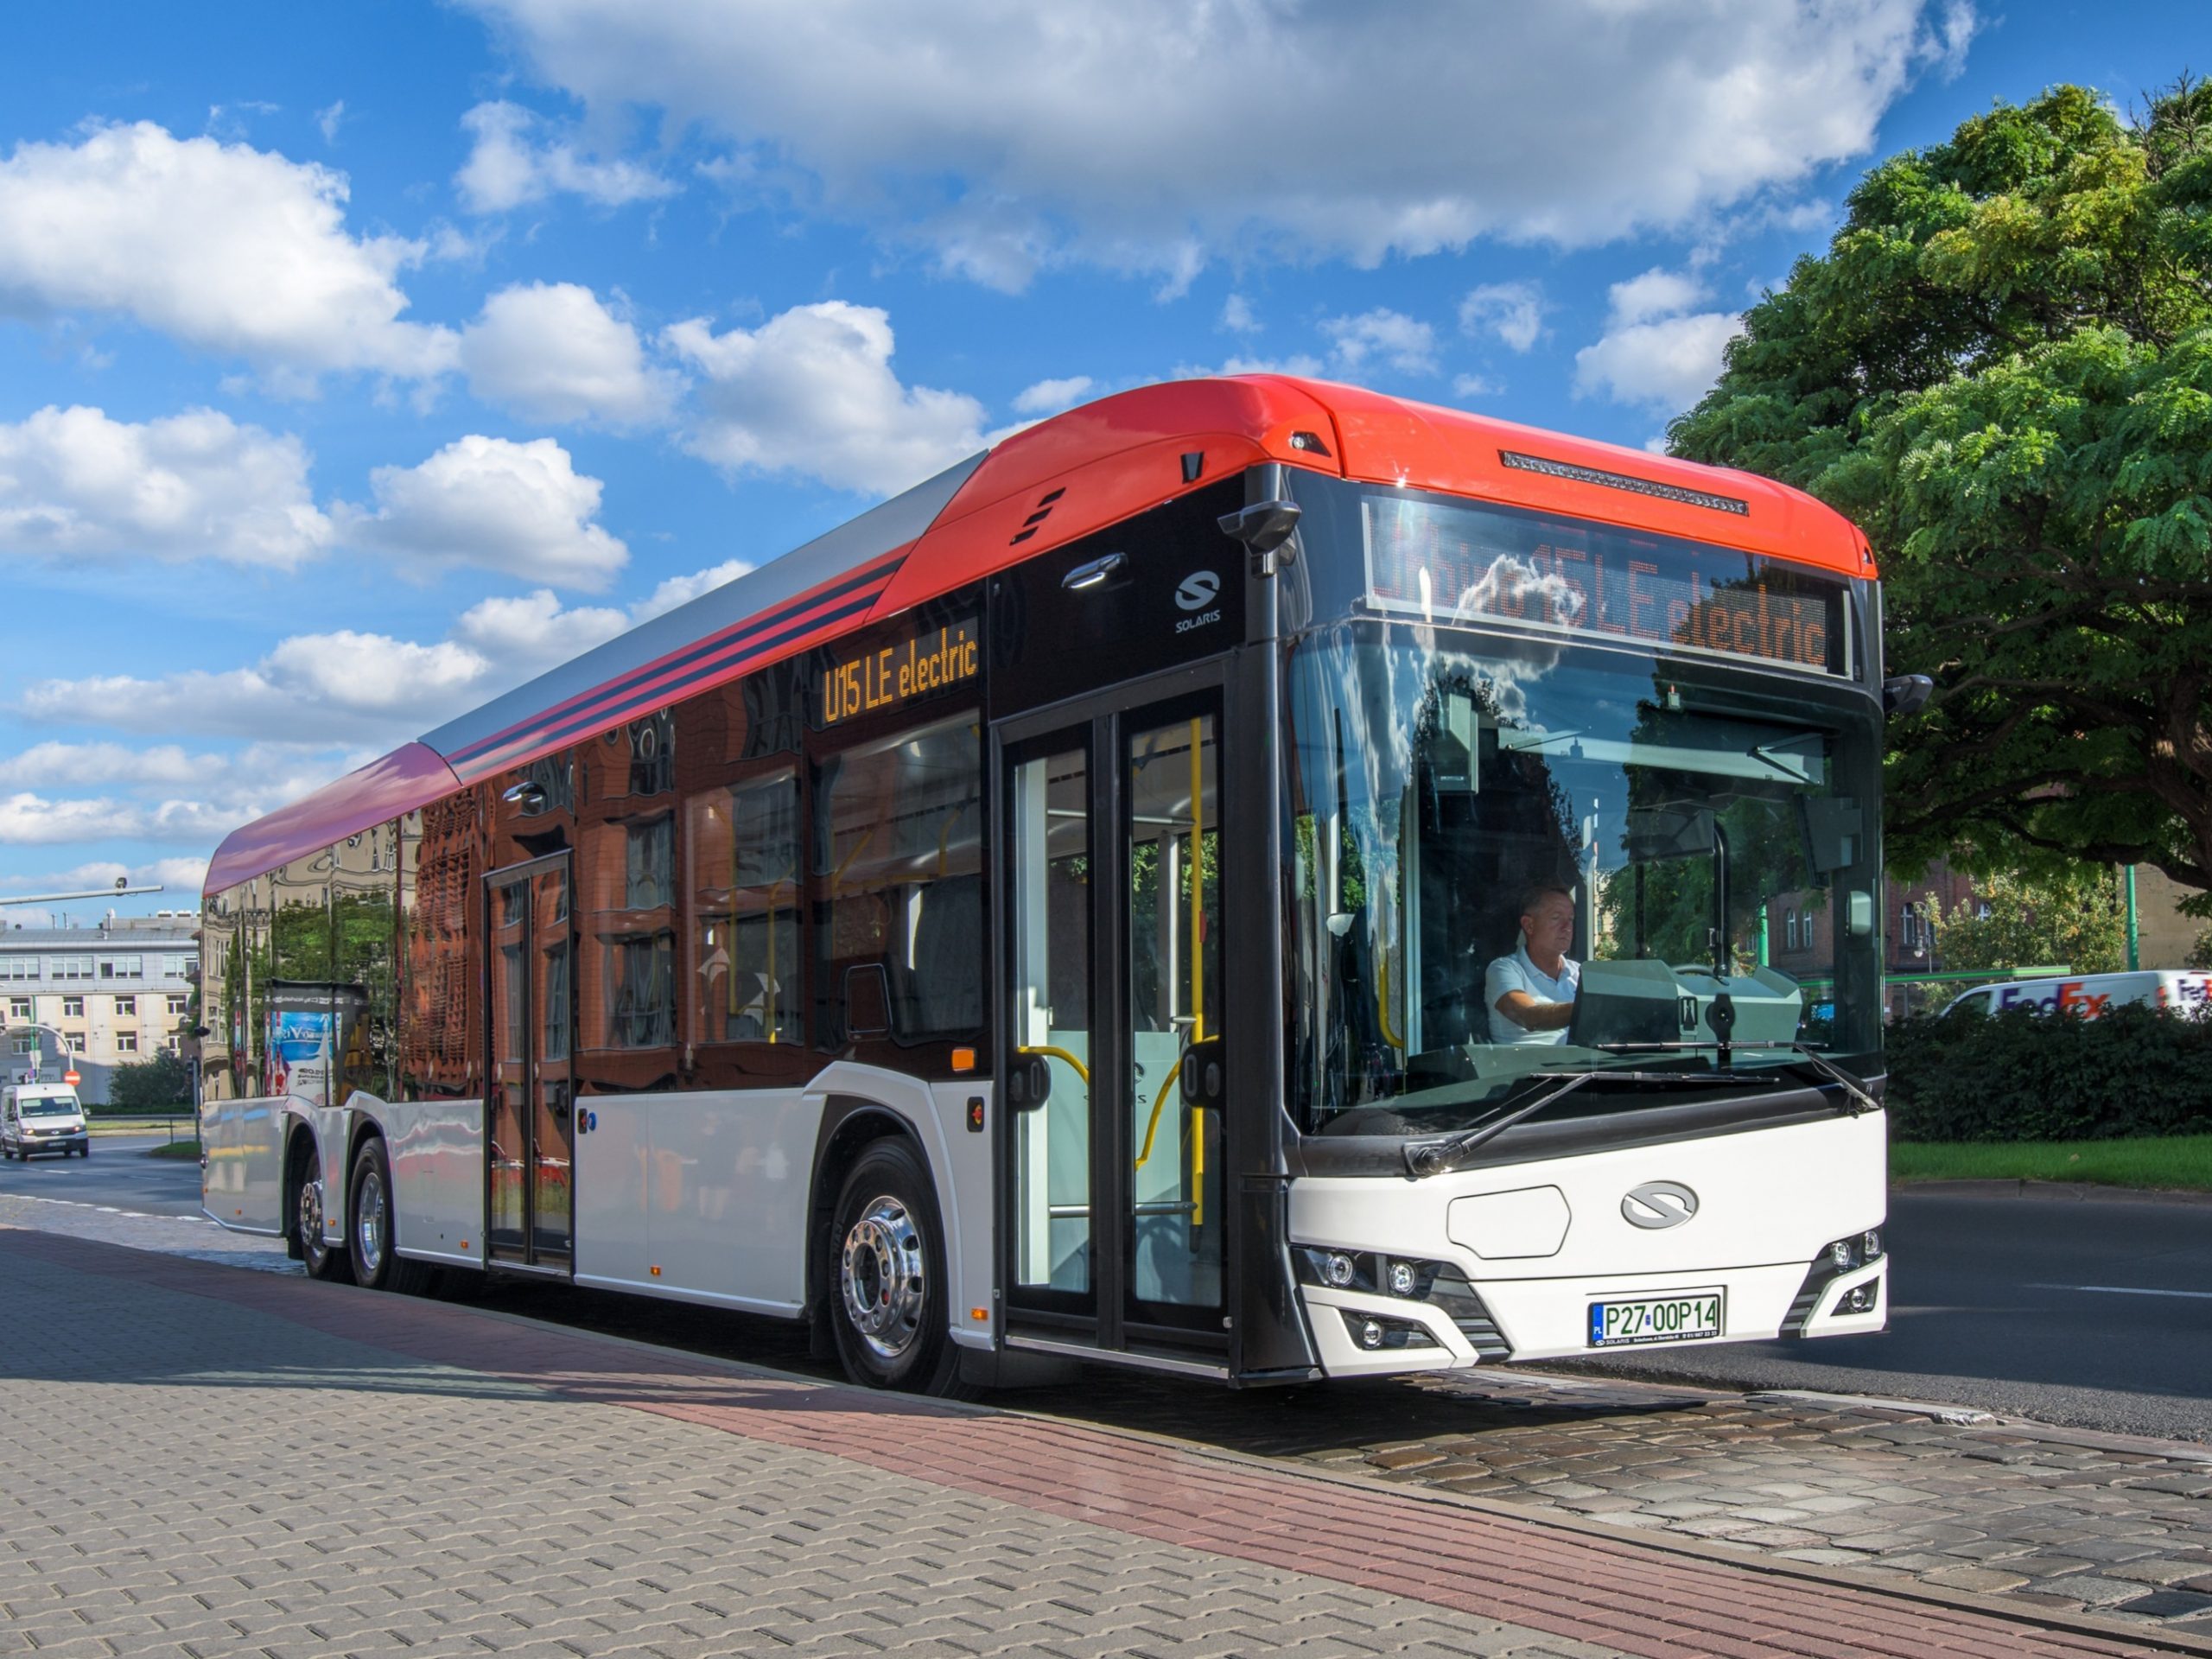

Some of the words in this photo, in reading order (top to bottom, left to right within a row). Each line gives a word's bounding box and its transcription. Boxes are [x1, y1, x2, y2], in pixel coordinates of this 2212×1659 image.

[1175, 609, 1220, 633] SOLARIS
[1595, 553, 1660, 641] LE
[1668, 571, 1826, 667] electric
[825, 659, 861, 722] U15
[866, 647, 893, 709] LE
[899, 627, 977, 697] electric
